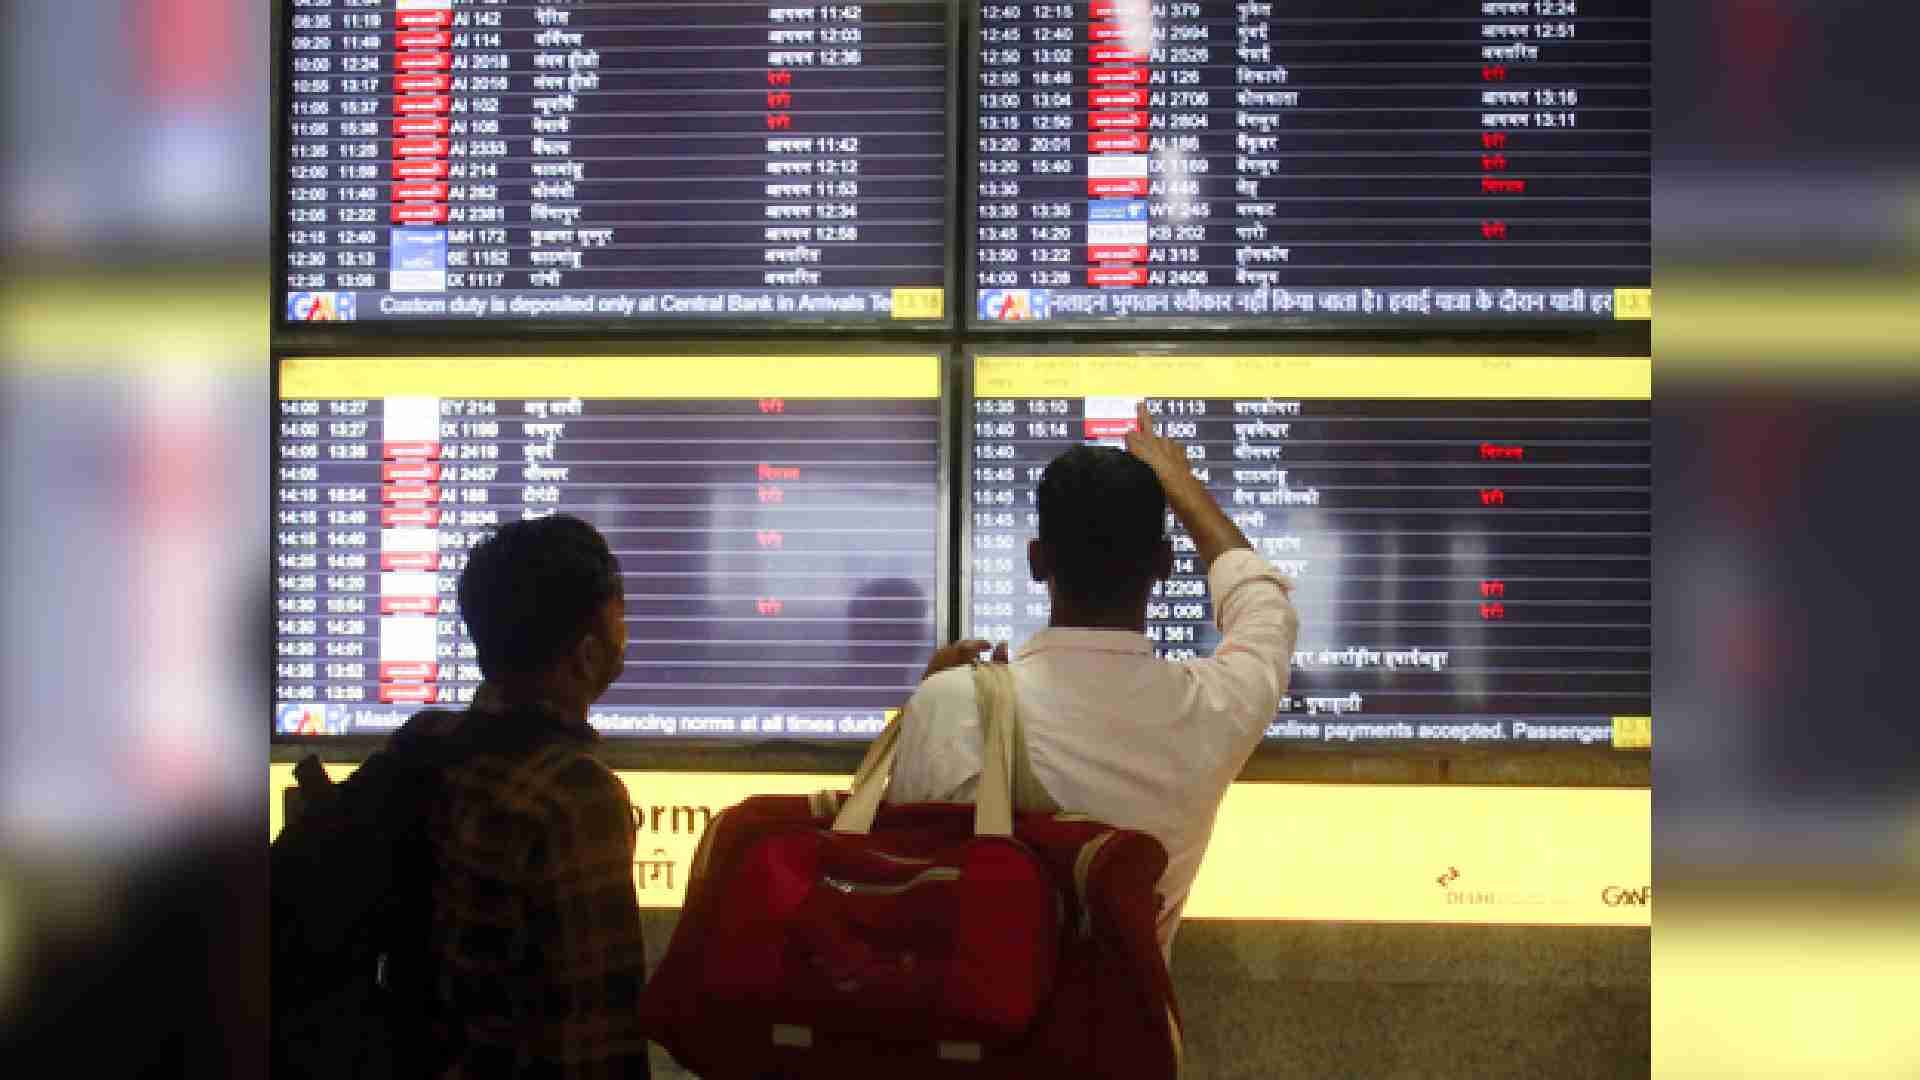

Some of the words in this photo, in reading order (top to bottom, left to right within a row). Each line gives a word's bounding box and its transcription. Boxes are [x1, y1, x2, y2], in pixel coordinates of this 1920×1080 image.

[821, 6, 861, 19] 11:42
[984, 6, 1020, 18] 12:40
[1033, 6, 1073, 18] 12:15
[1151, 4, 1165, 17] AI
[1171, 3, 1199, 18] 379
[1534, 0, 1575, 15] 12:24
[454, 12, 469, 25] AI
[821, 28, 861, 42] 12:03
[981, 28, 1020, 40] 12:45
[1034, 28, 1073, 40] 12:40
[1151, 26, 1165, 39] AI
[1534, 24, 1574, 37] 12:51
[453, 34, 467, 46] AI
[473, 34, 501, 46] 114
[451, 55, 467, 68] AI
[981, 50, 1020, 65] 12:50
[1033, 50, 1072, 62] 13:02
[1151, 49, 1165, 62] AI
[451, 77, 467, 90] AI
[980, 72, 1020, 86] 12:55
[1150, 71, 1165, 83] AI
[1171, 71, 1199, 83] 126
[980, 94, 1020, 108] 13:00
[1033, 94, 1070, 107] 13:04
[1150, 92, 1165, 105] AI
[1171, 92, 1208, 105] 2706
[1534, 89, 1577, 105] 13:16
[451, 98, 467, 112] AI
[451, 120, 467, 133] AI
[980, 116, 1020, 129] 13:15
[1033, 116, 1073, 129] 12:50
[1150, 114, 1165, 129] AI
[1535, 114, 1574, 126] 13:11
[451, 141, 467, 156] AI
[817, 138, 857, 151] 11:42
[980, 138, 1020, 151] 13:20
[1031, 138, 1070, 151] 20:01
[1150, 138, 1167, 153] AI
[292, 166, 328, 178] 12:00
[450, 165, 464, 177] AI
[470, 163, 497, 177] 214
[817, 160, 857, 173] 12:12
[980, 160, 1019, 172] 13:20
[1033, 160, 1070, 172] 15:40
[1150, 158, 1166, 171] IX
[292, 188, 328, 200] 12:00
[448, 187, 464, 200] AI
[980, 182, 1018, 196] 13:30
[1150, 182, 1165, 195] AI
[339, 209, 375, 221] 12:22
[448, 209, 464, 221] AI
[817, 205, 857, 218] 12:34
[980, 204, 1017, 218] 13:35
[1033, 204, 1070, 218] 13:35
[1150, 203, 1174, 216] WY
[288, 231, 325, 243] 12:15
[338, 231, 375, 243] 12:40
[449, 230, 473, 243] MH
[479, 228, 504, 243] 172
[980, 228, 1017, 240] 13:45
[1033, 228, 1070, 240] 14:20
[1150, 225, 1171, 240] KB
[1175, 225, 1205, 240] 202
[288, 252, 325, 265] 12:30
[473, 250, 507, 265] 1152
[980, 249, 1017, 261] 13:50
[1033, 249, 1070, 261] 13:22
[1150, 249, 1165, 261] AI
[1169, 248, 1199, 261] 315
[448, 273, 464, 286] IX
[470, 273, 504, 286] 1117
[980, 271, 1017, 283] 14:00
[1031, 271, 1070, 284] 13:28
[1149, 271, 1165, 283] AI
[1168, 271, 1208, 283] 2406
[380, 296, 446, 313] Custom
[450, 295, 487, 316] duty
[491, 295, 506, 312] is
[510, 295, 593, 315] deposited
[599, 295, 634, 315] only
[639, 296, 655, 311] at
[660, 295, 723, 311] Central
[728, 295, 772, 311] Bank
[777, 295, 793, 311] in
[799, 295, 865, 311] Arrivals
[1112, 292, 1168, 316] भुगतान
[1173, 289, 1229, 312] स्वीकार
[1236, 286, 1269, 313] नहीं
[1273, 290, 1315, 312] किया
[1389, 289, 1431, 314] हवाई
[1476, 289, 1493, 312] के
[1499, 289, 1545, 312] दौरान
[282, 400, 319, 415] 14:00
[975, 400, 1014, 414] 15:35
[1027, 400, 1068, 414] 15:10
[1168, 400, 1205, 414] 1113
[282, 422, 319, 437] 14:00
[975, 423, 1014, 437] 15:40
[1027, 423, 1068, 437] 15:14
[1167, 423, 1197, 437] 500
[282, 444, 319, 458] 14:05
[442, 445, 456, 458] AI
[975, 445, 1014, 459] 15:40
[282, 465, 318, 480] 14:05
[442, 467, 456, 480] AI
[975, 468, 1014, 482] 15:45
[279, 489, 316, 502] 14:15
[441, 489, 455, 502] AI
[974, 490, 1014, 504] 15:45
[279, 511, 316, 523] 14:15
[441, 511, 455, 524] AI
[974, 513, 1014, 527] 15:45
[279, 532, 316, 544] 14:15
[680, 715, 735, 730] norms
[741, 713, 757, 730] at
[762, 711, 783, 731] all
[787, 711, 835, 732] times
[840, 713, 887, 733] durin
[1266, 721, 1320, 738] online
[1325, 721, 1414, 741] payments
[1419, 721, 1507, 741] accepted.
